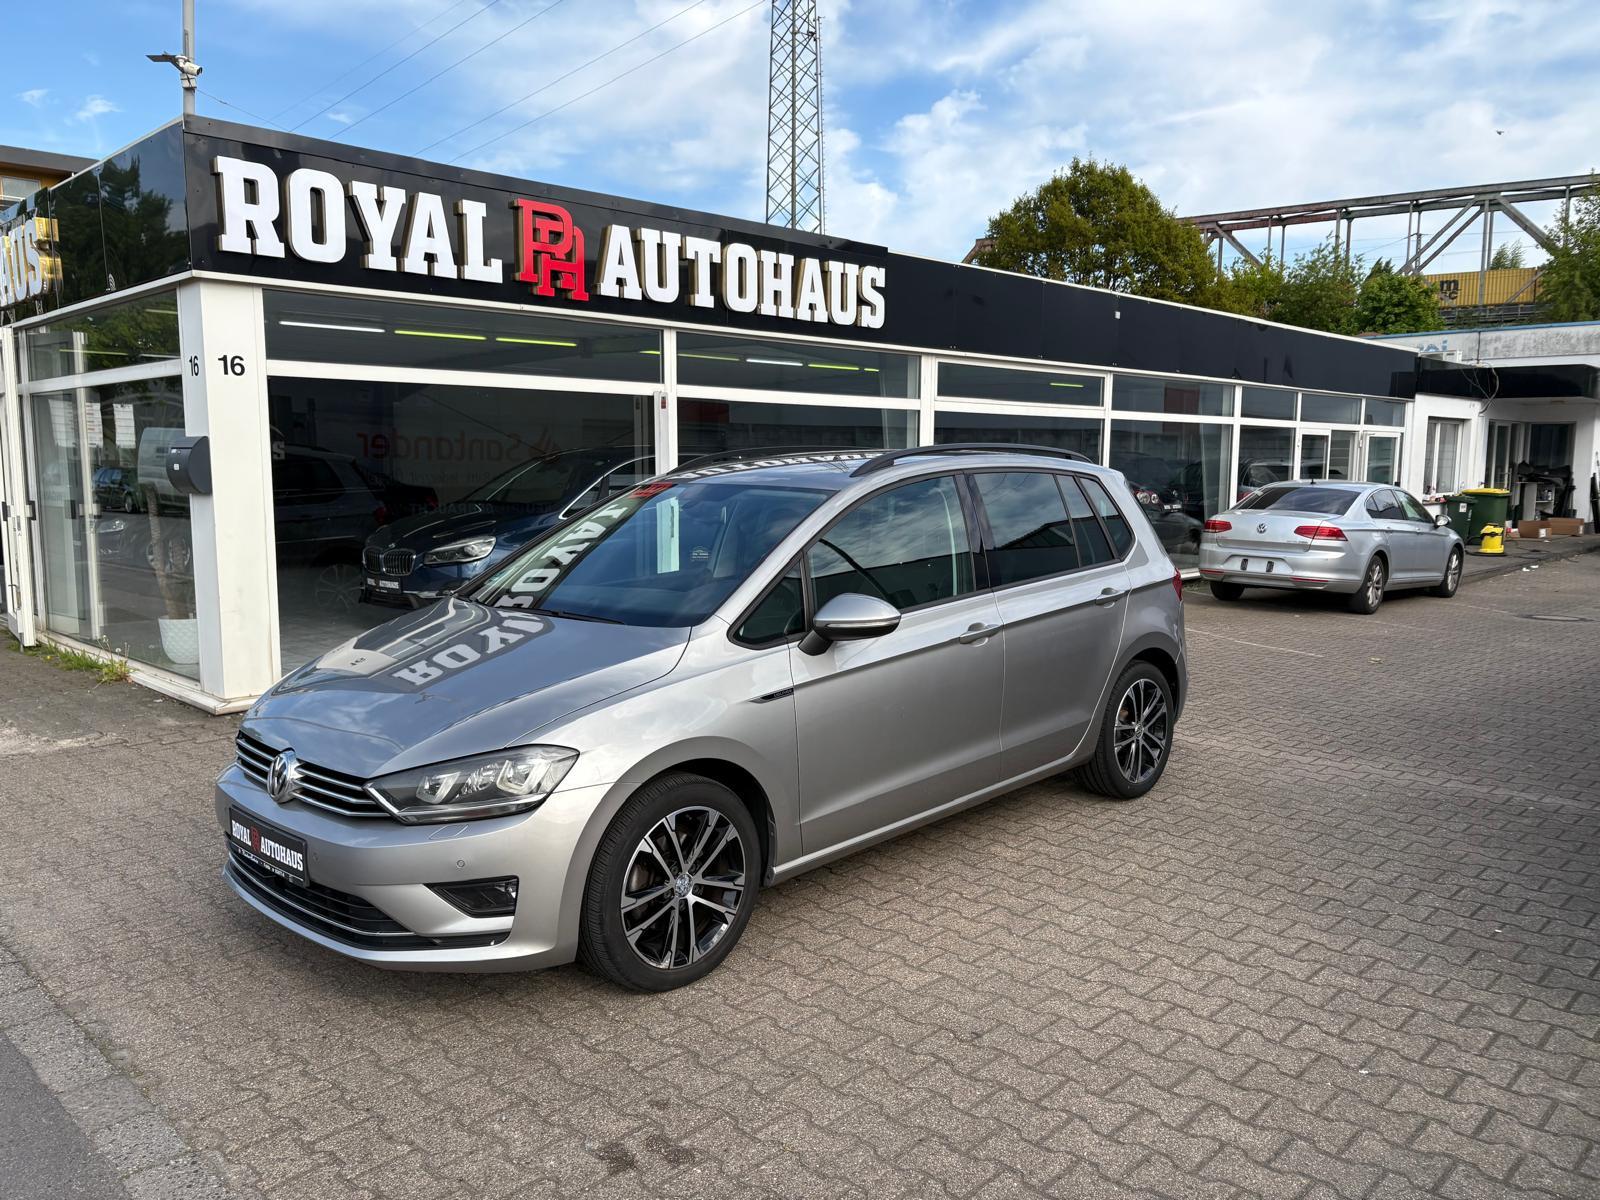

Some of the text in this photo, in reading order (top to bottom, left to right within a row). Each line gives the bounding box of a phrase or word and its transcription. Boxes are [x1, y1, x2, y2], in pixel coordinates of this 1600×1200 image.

[213, 155, 503, 284] ROYAL
[598, 224, 886, 329] AUTOHAUS
[188, 355, 200, 378] 16
[217, 355, 246, 377] 16
[232, 820, 252, 846] ROYAL
[261, 836, 304, 871] AUTOHAUS
